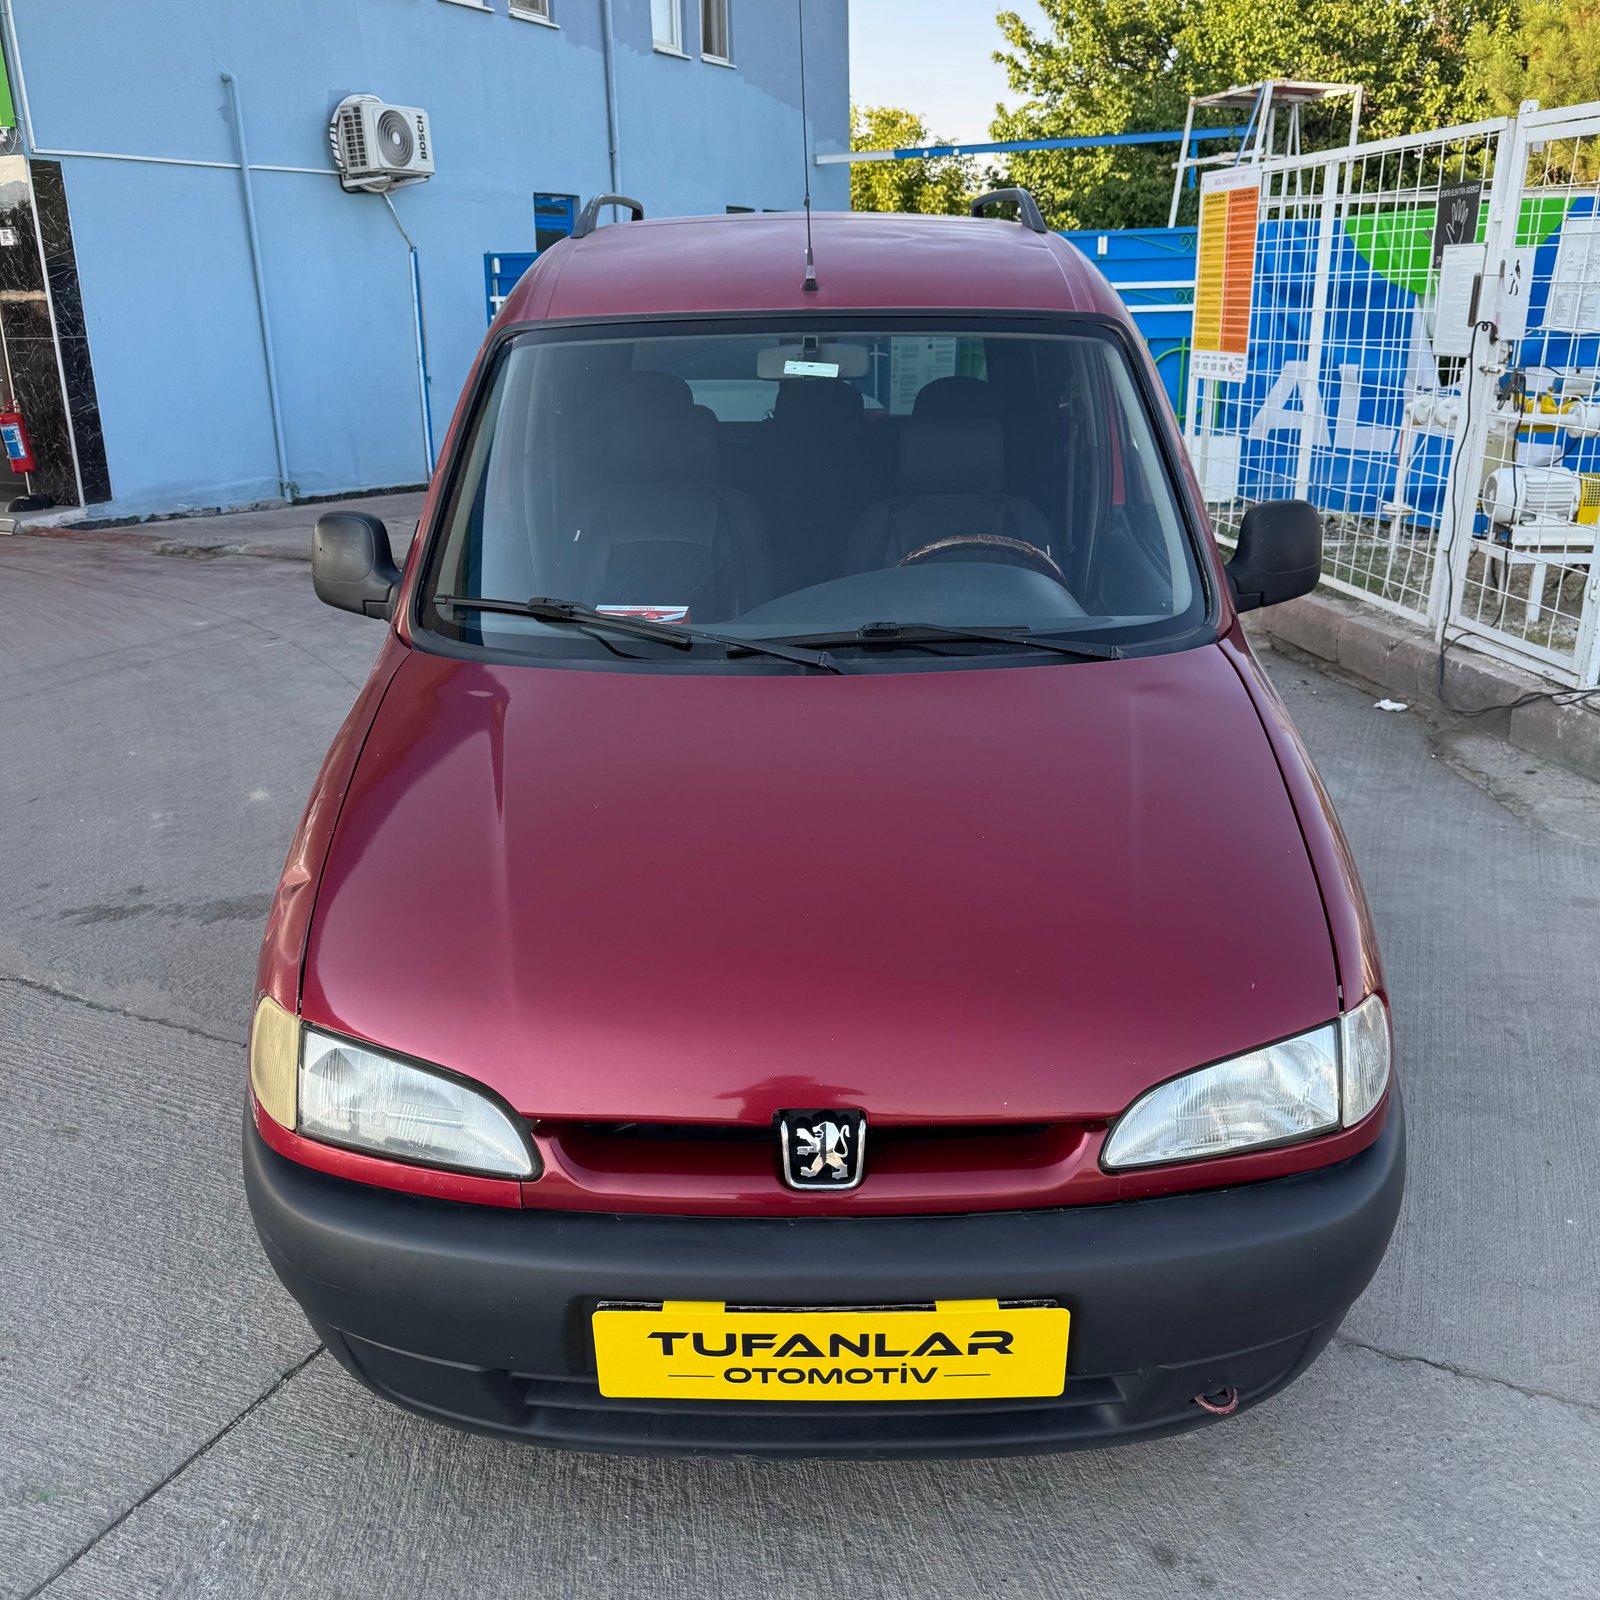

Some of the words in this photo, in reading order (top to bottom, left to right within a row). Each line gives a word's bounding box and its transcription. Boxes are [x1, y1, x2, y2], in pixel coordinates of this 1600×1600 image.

[416, 114, 428, 160] BOSCH
[647, 1331, 1014, 1358] TUFANLAR
[723, 1362, 938, 1385] OTOMOTİV
